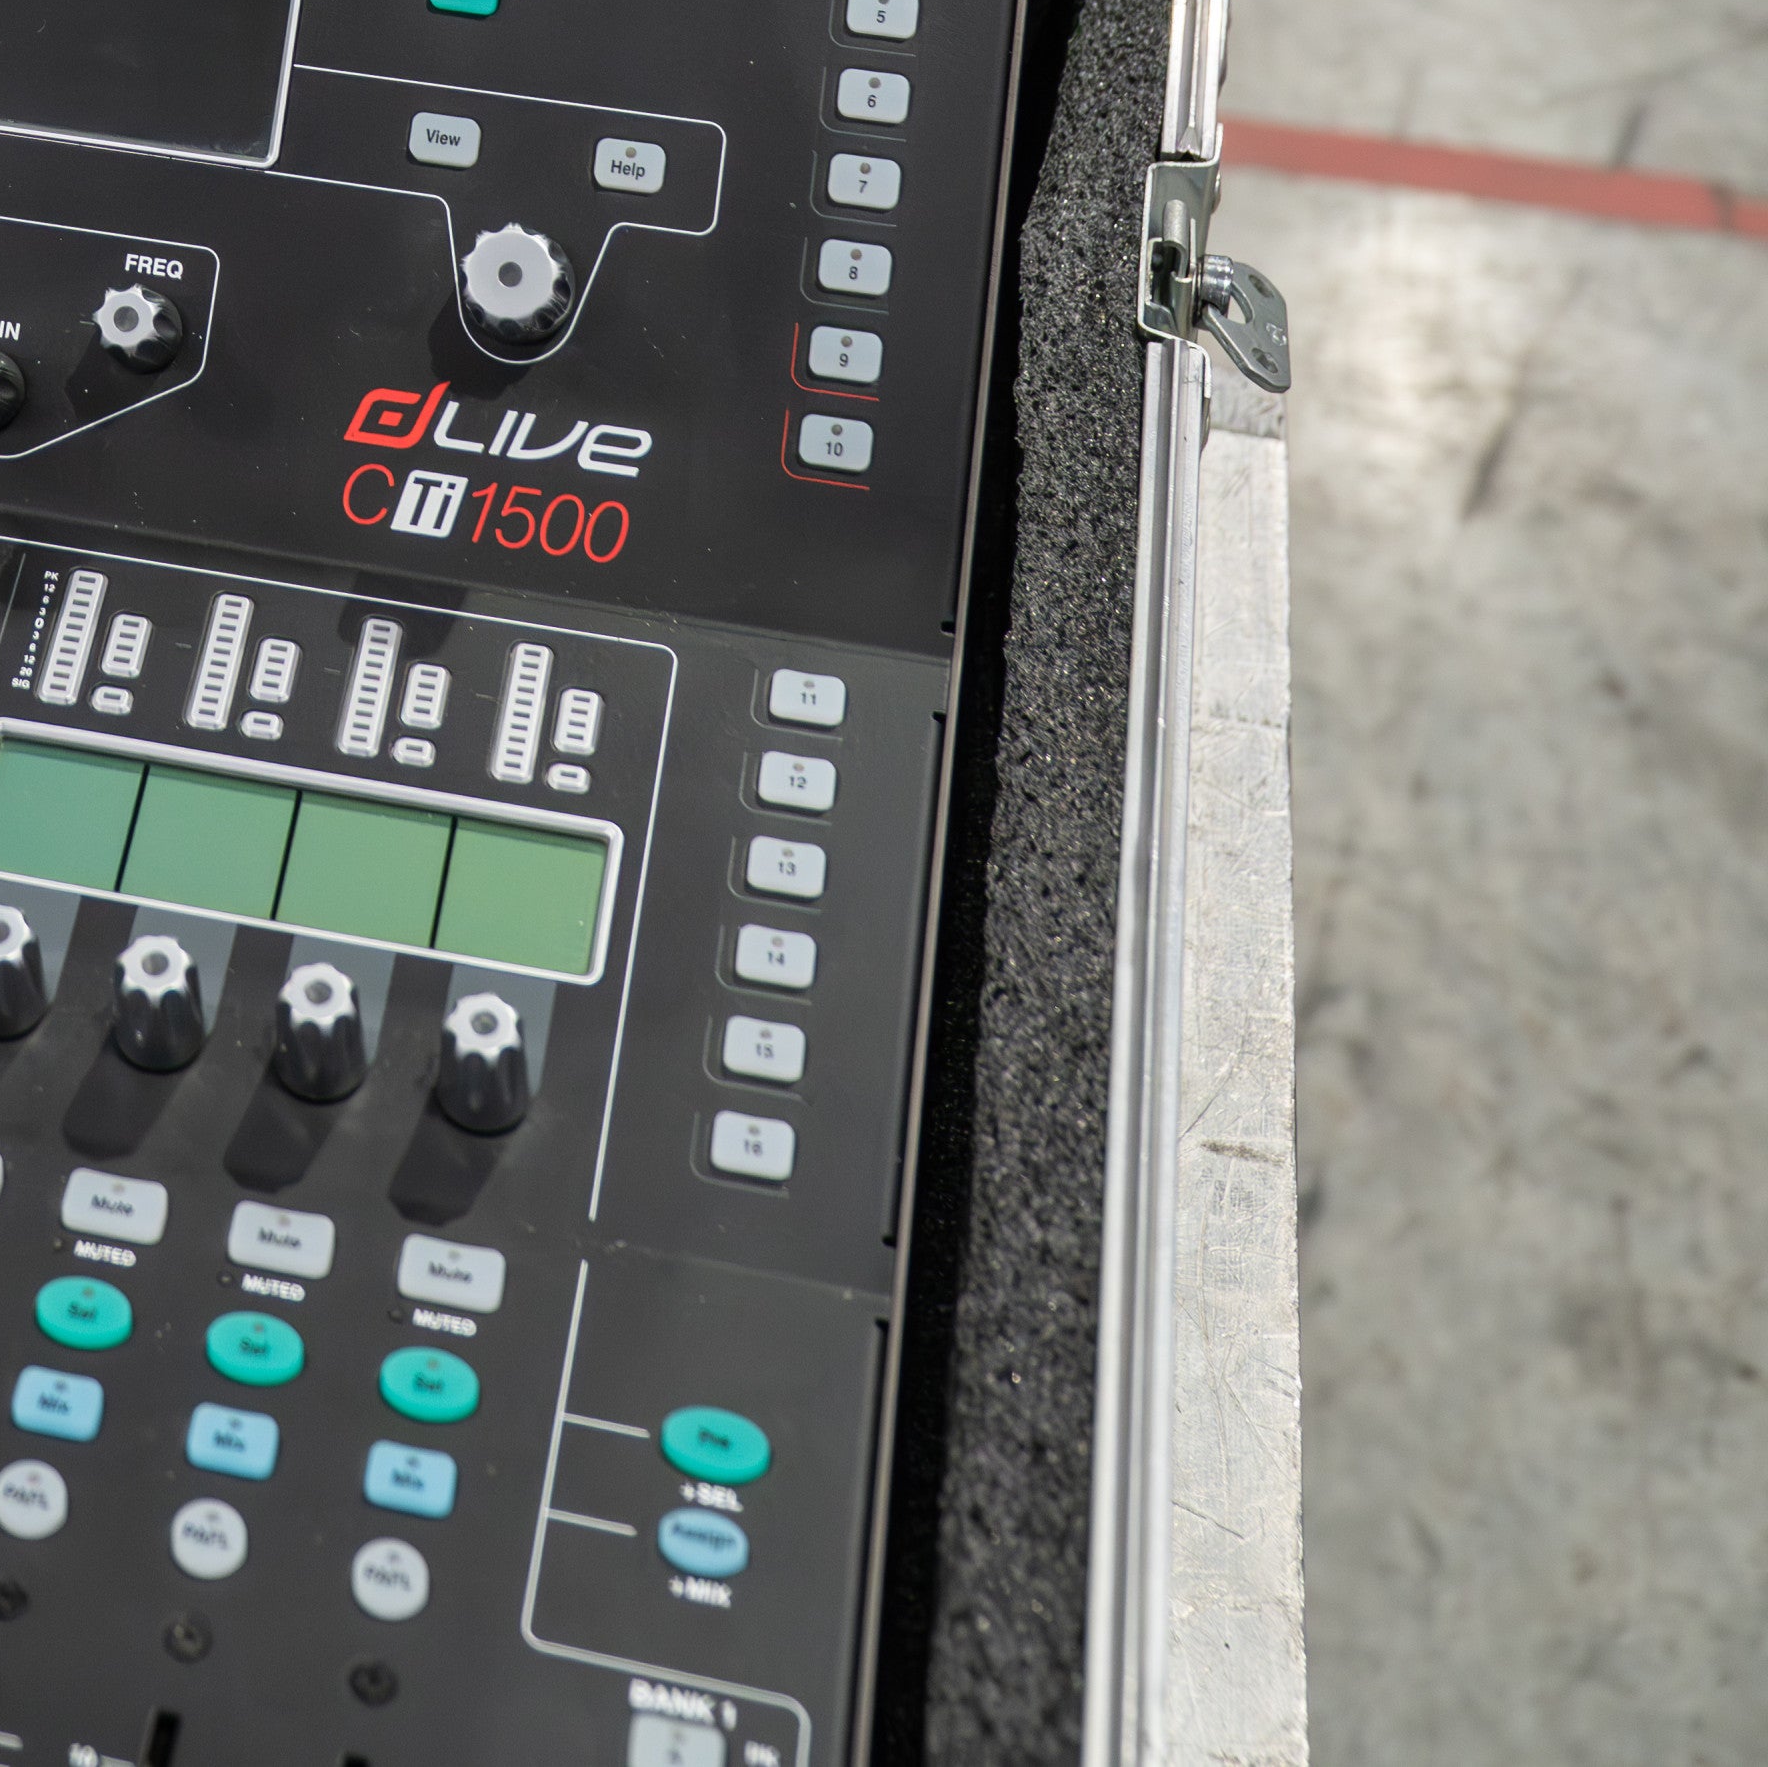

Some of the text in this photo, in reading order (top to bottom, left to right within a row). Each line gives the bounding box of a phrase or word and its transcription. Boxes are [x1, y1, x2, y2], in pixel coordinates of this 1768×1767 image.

[877, 10, 885, 23] 5
[868, 95, 876, 107] 6
[427, 129, 460, 146] View
[611, 160, 645, 179] Help
[859, 180, 867, 192] 7
[125, 254, 183, 279] FREQ
[849, 266, 857, 279] 8
[840, 354, 848, 366] 9
[827, 442, 843, 456] 10
[802, 693, 816, 704] 11
[790, 776, 806, 788] 12
[779, 862, 795, 875] 13
[768, 952, 784, 964] 14
[756, 1044, 773, 1058] 15
[744, 1140, 762, 1154] 16
[75, 1240, 136, 1266] MUTED
[242, 1274, 304, 1301] MUTED
[628, 1678, 716, 1726] BANK
